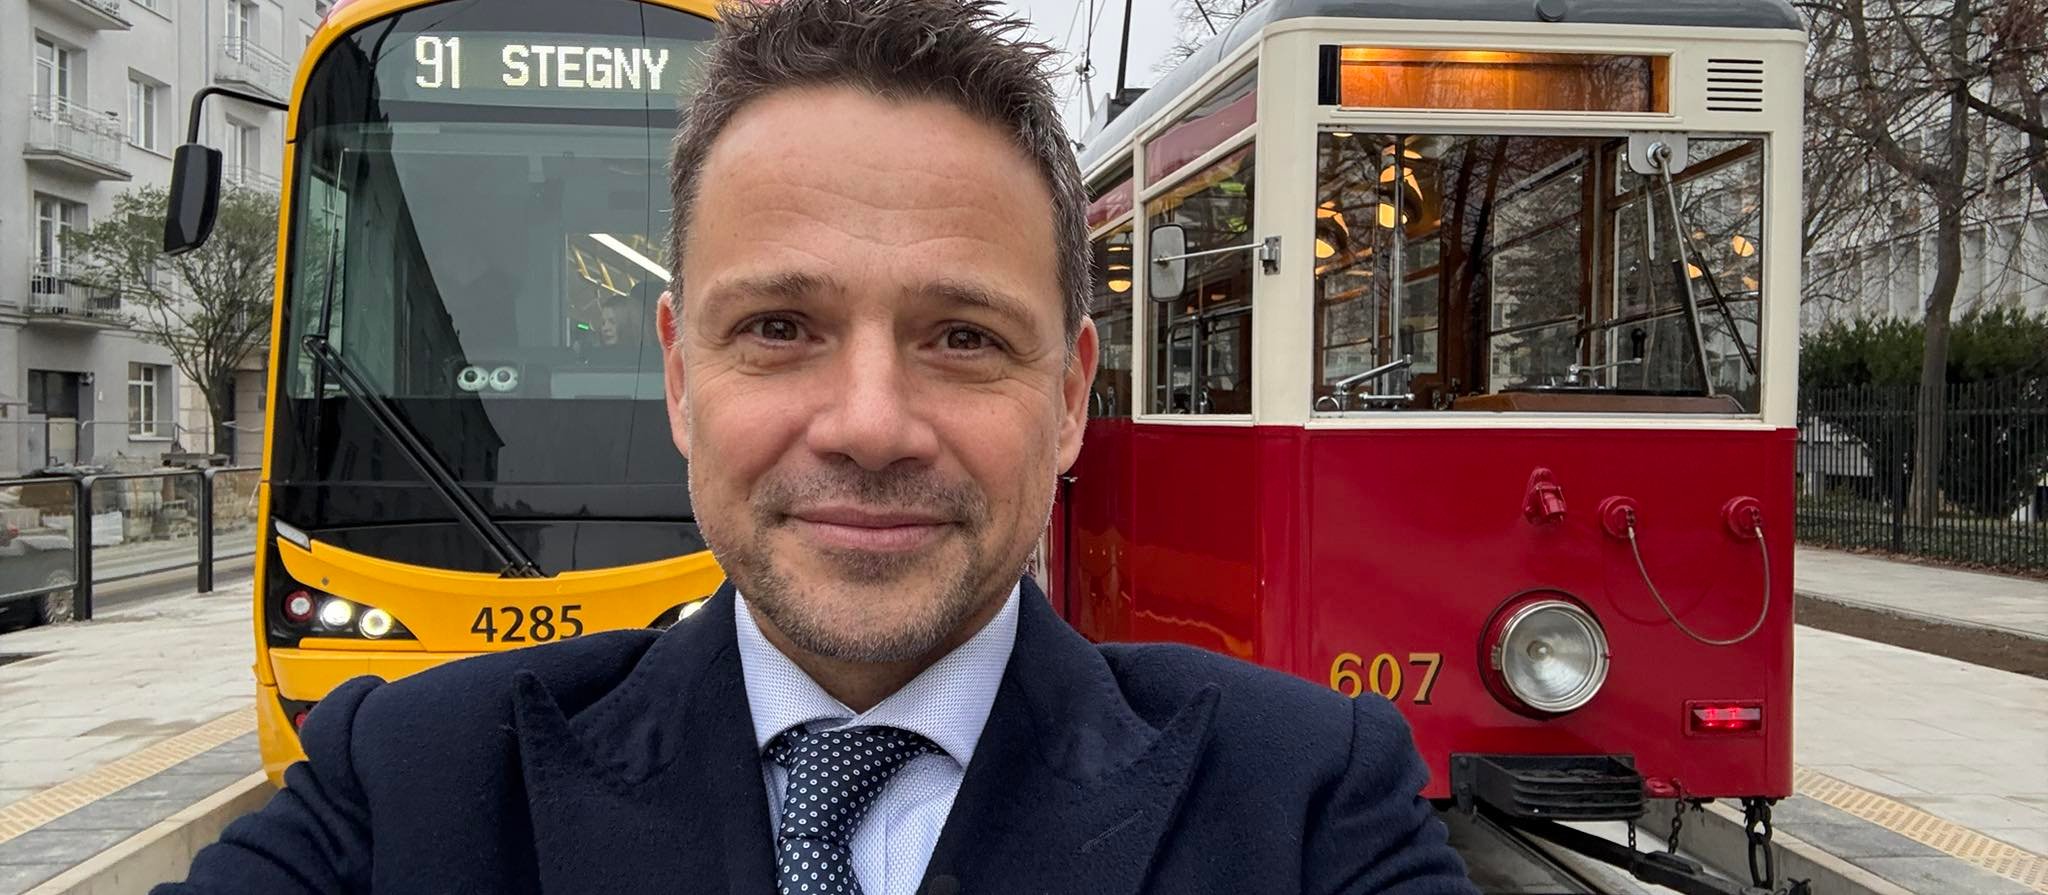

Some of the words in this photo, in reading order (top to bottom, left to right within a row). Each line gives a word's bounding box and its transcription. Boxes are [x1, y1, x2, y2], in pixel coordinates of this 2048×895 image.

[416, 36, 460, 89] 91
[502, 45, 669, 90] STEGNY
[471, 604, 583, 643] 4285
[1330, 652, 1443, 705] 607
